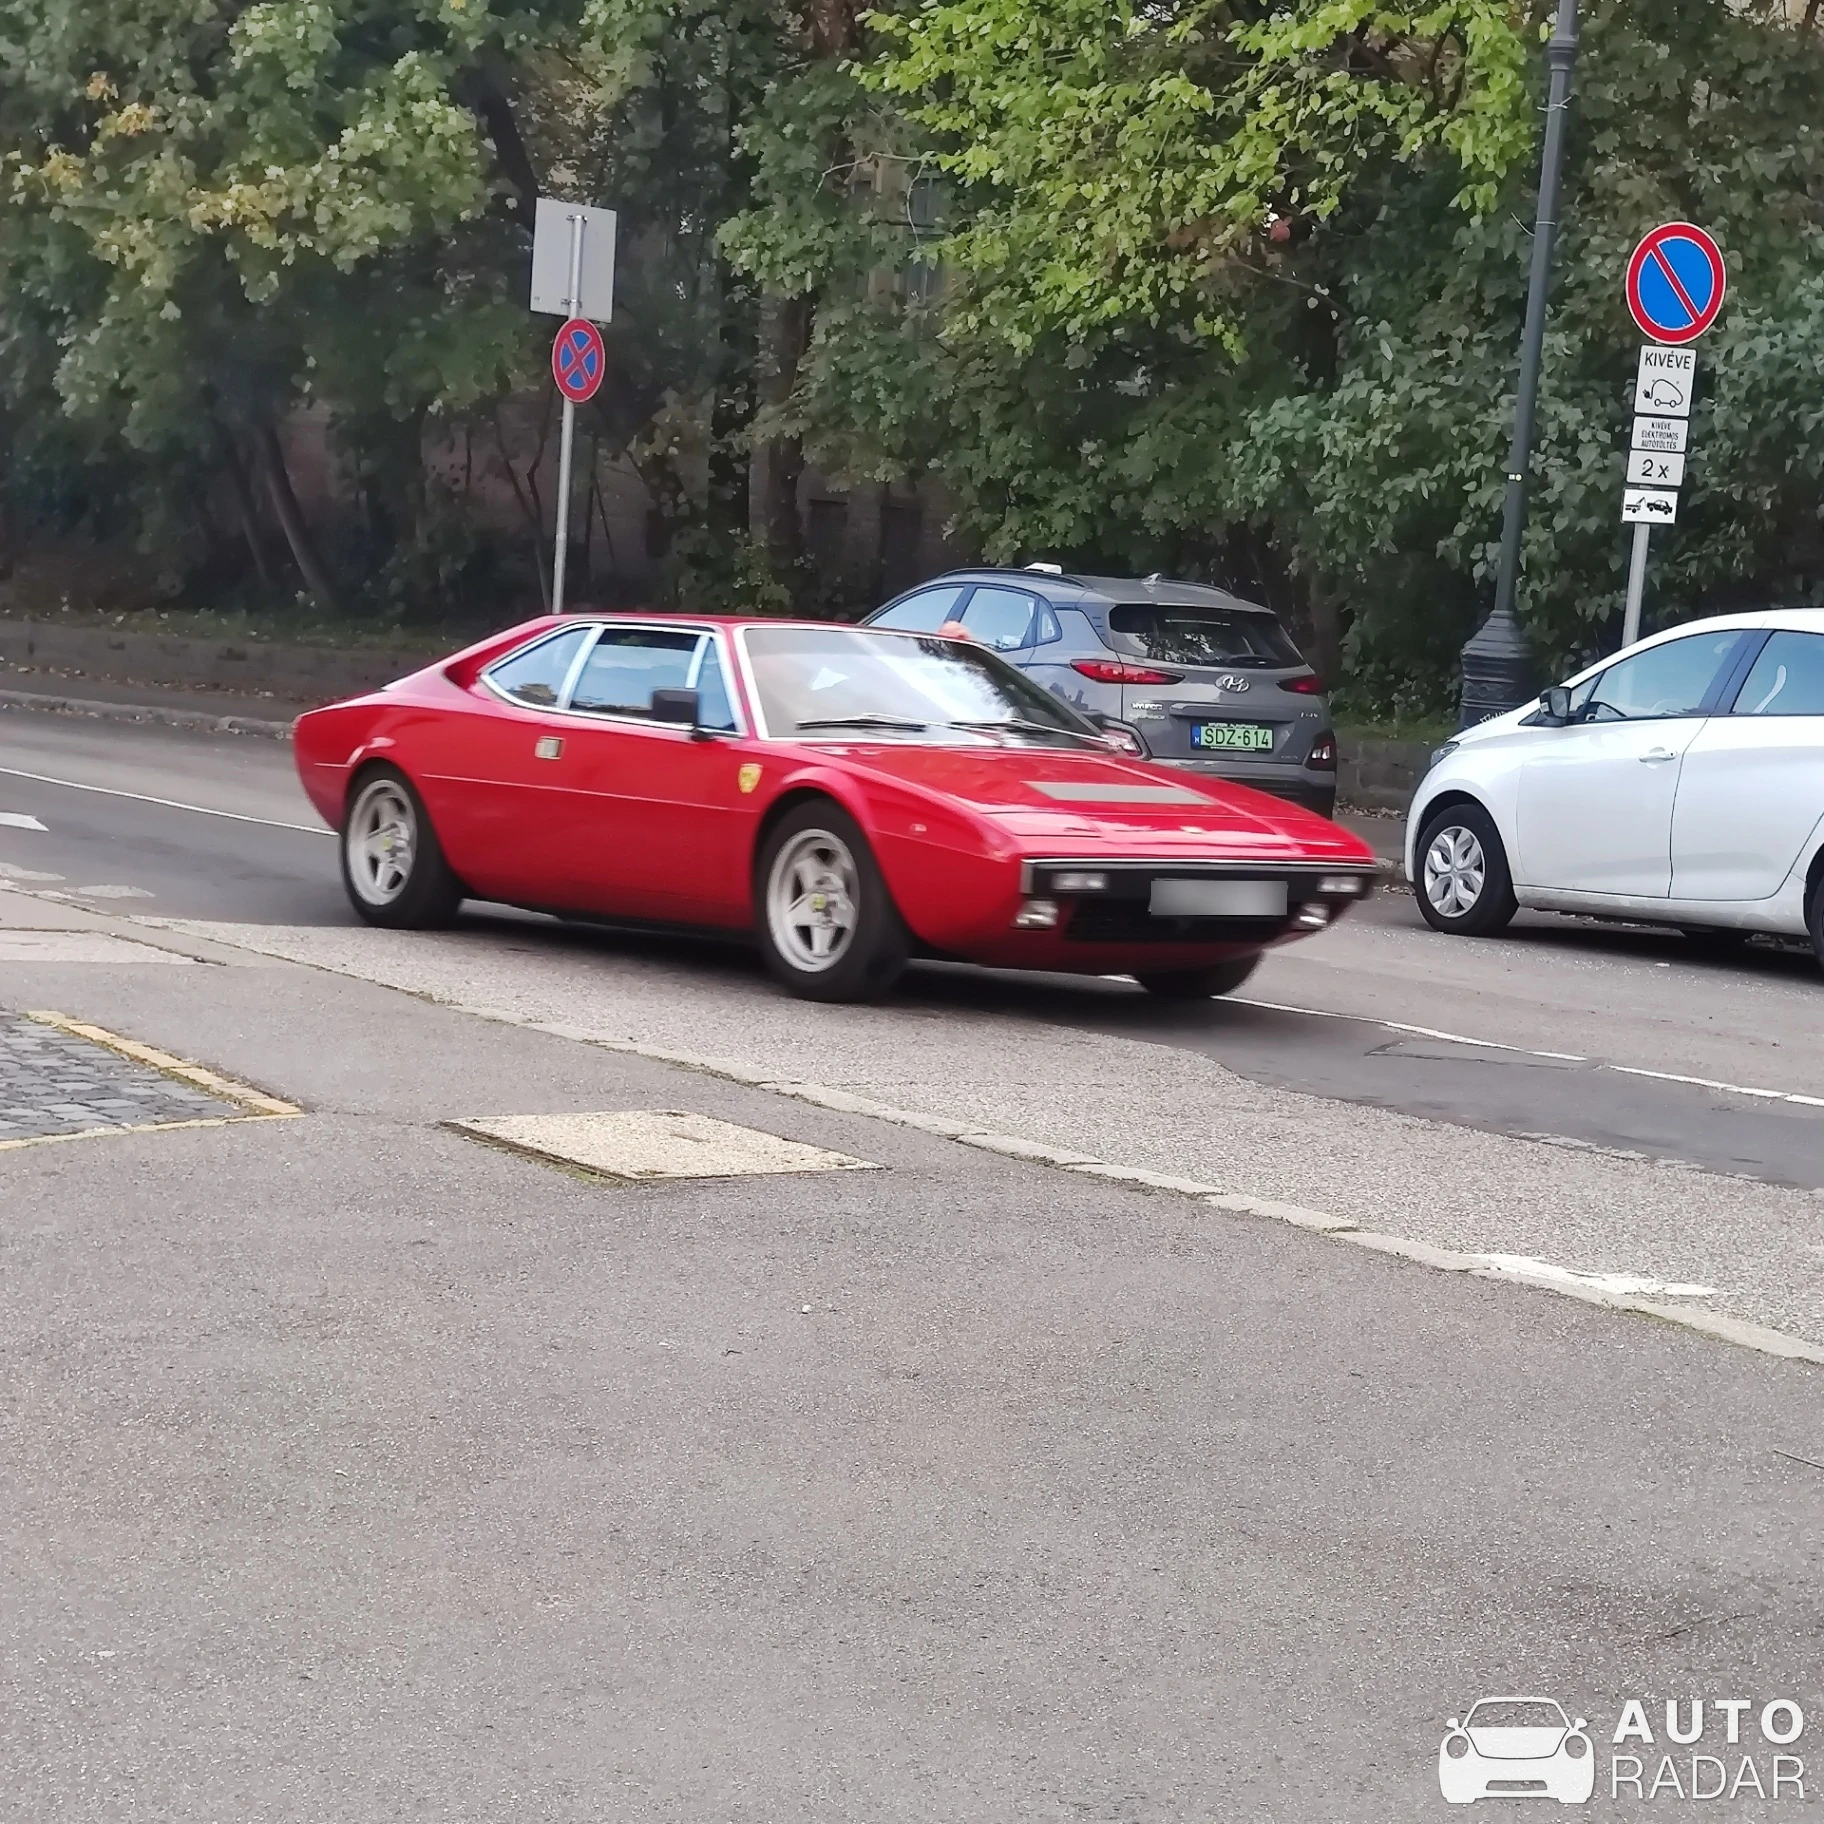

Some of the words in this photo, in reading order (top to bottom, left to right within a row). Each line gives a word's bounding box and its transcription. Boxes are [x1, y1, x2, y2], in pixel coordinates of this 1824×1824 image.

[1645, 350, 1691, 369] KIVÉVE
[1641, 459, 1653, 477] 2
[1204, 728, 1269, 747] SDZ-614
